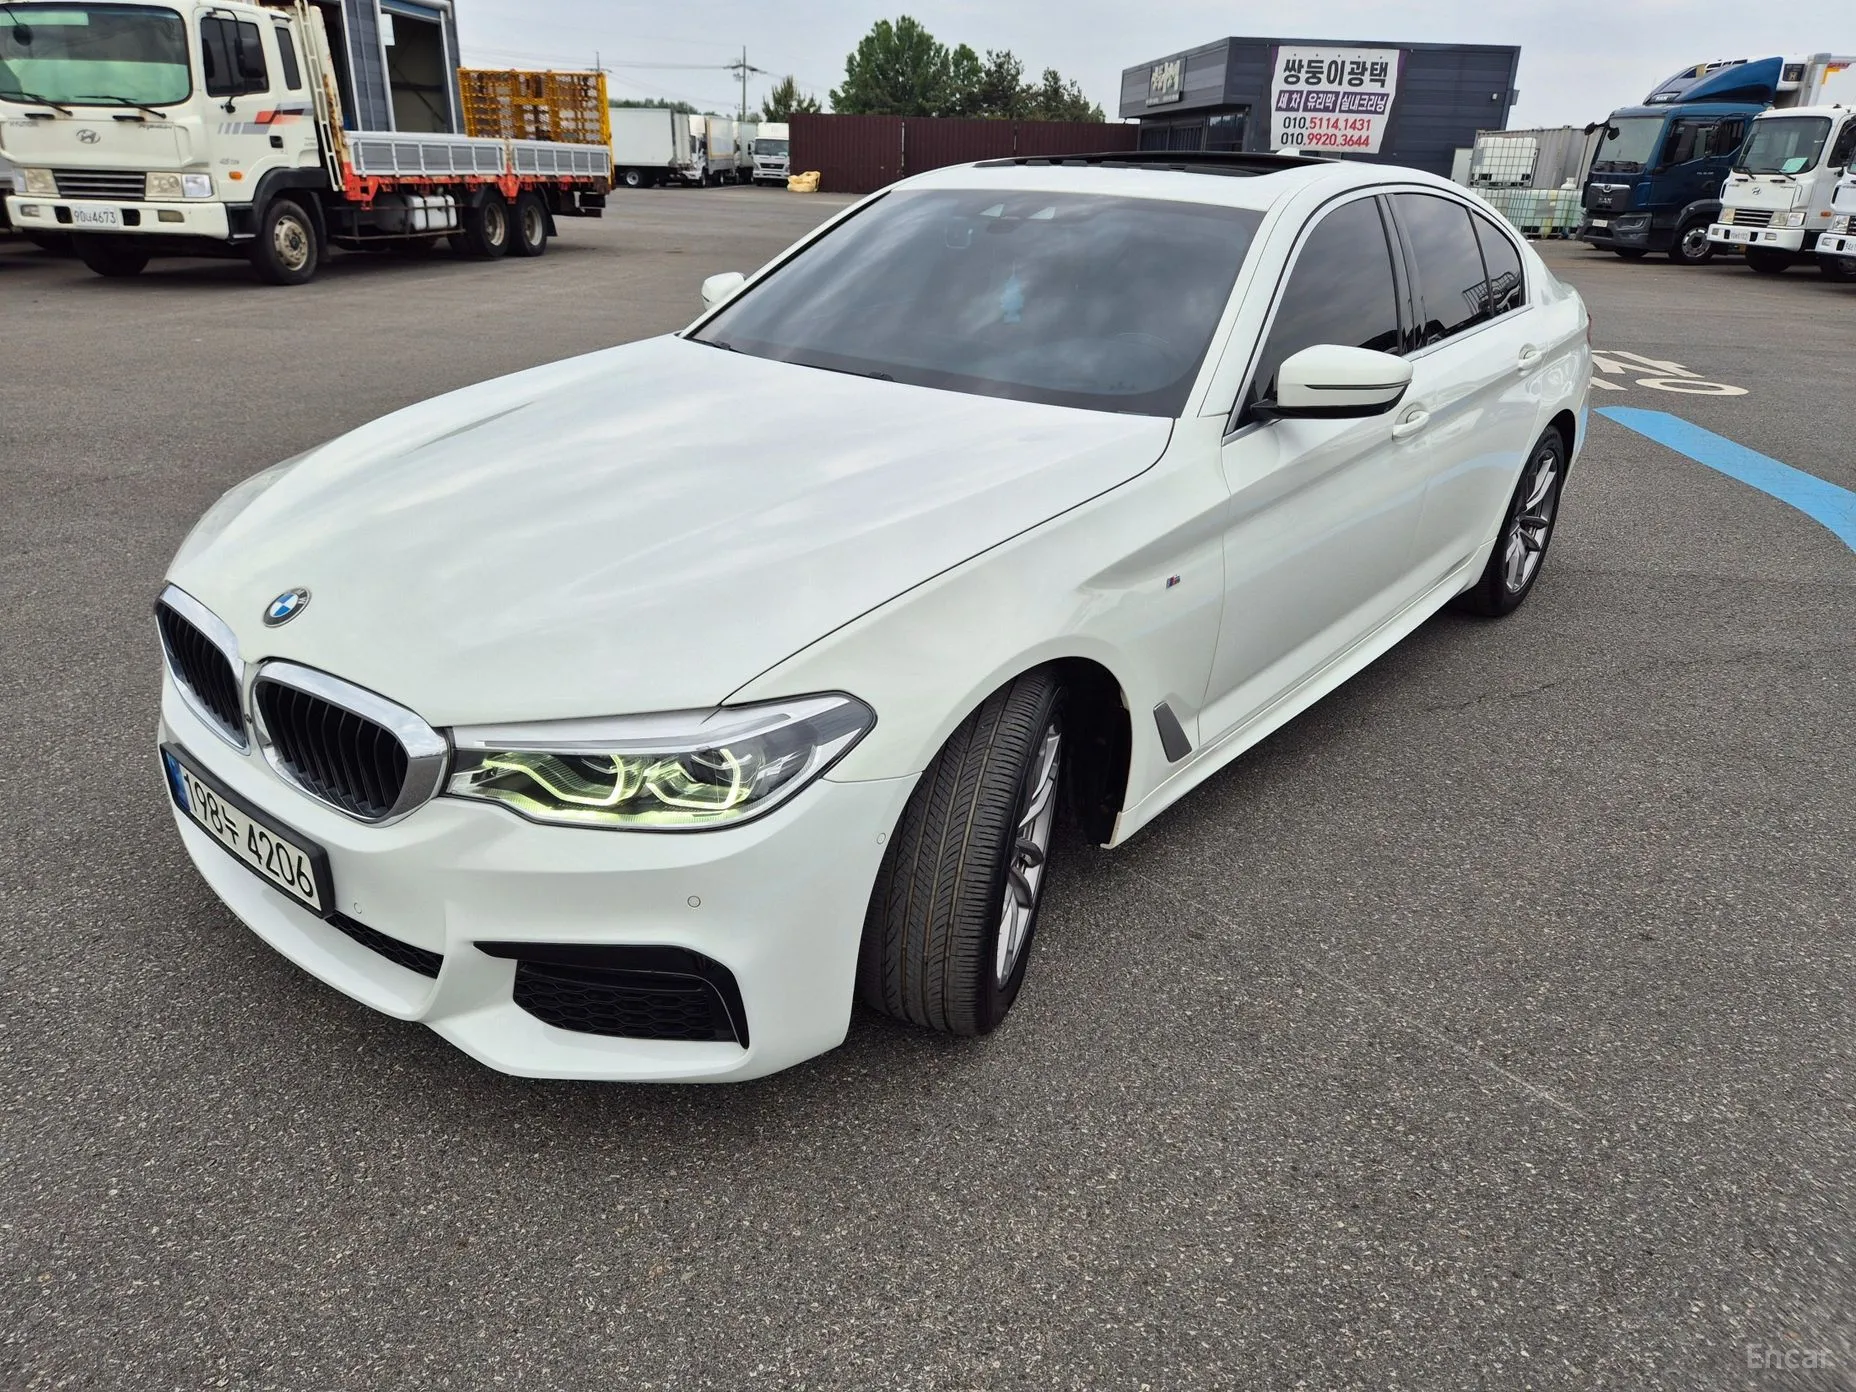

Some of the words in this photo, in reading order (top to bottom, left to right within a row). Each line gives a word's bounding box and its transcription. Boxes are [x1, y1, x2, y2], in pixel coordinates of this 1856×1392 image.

[1283, 59, 1389, 88] 쌍둥이광택
[1306, 93, 1335, 110] 유리막
[1340, 94, 1387, 112] 실내크리닝
[1282, 116, 1372, 131] 010.5114.1431
[1280, 132, 1370, 147] 010.9920.3644
[183, 773, 240, 845] 198누
[247, 823, 314, 898] 4206
